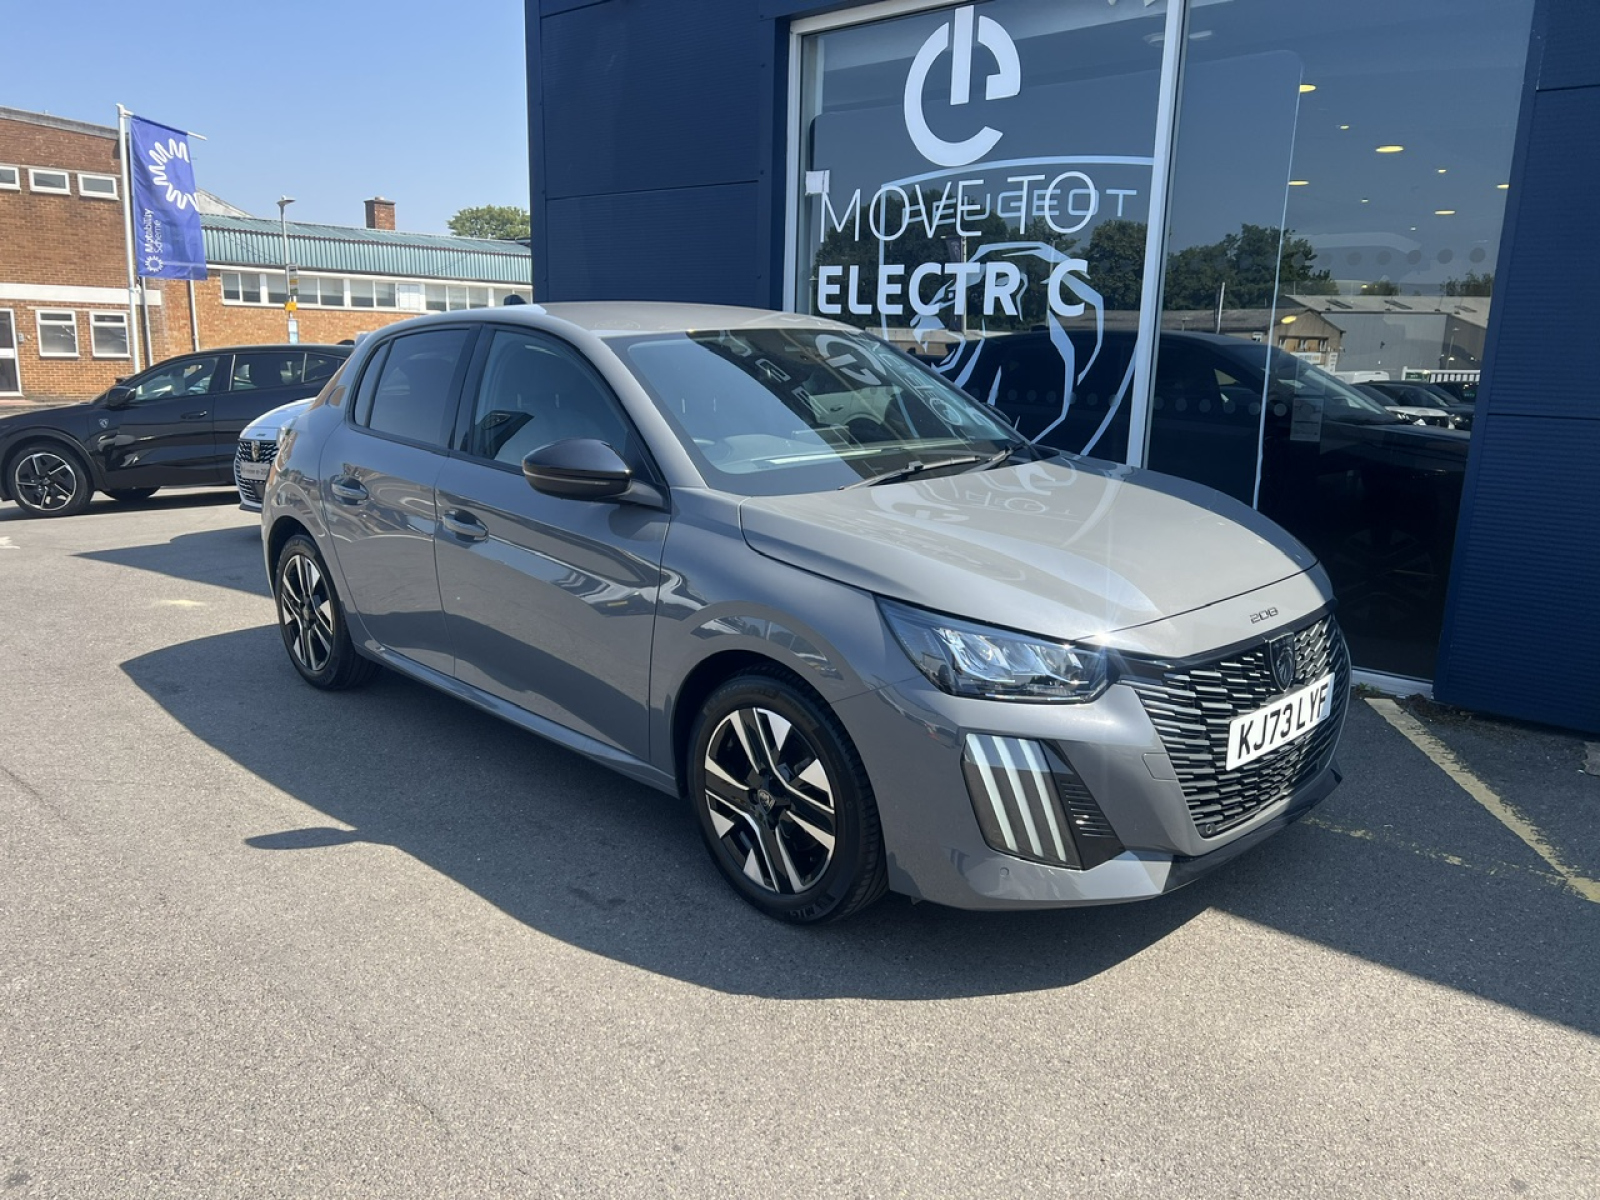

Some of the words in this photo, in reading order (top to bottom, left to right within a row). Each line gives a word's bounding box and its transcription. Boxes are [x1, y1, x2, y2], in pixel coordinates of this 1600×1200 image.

[153, 219, 163, 253] Scheme
[820, 179, 985, 243] MOVE
[1007, 171, 1098, 235] TO
[817, 258, 1091, 317] ELECTRC
[1250, 607, 1279, 624] 208
[1237, 702, 1294, 760] KJ73
[1295, 682, 1329, 731] LYF
